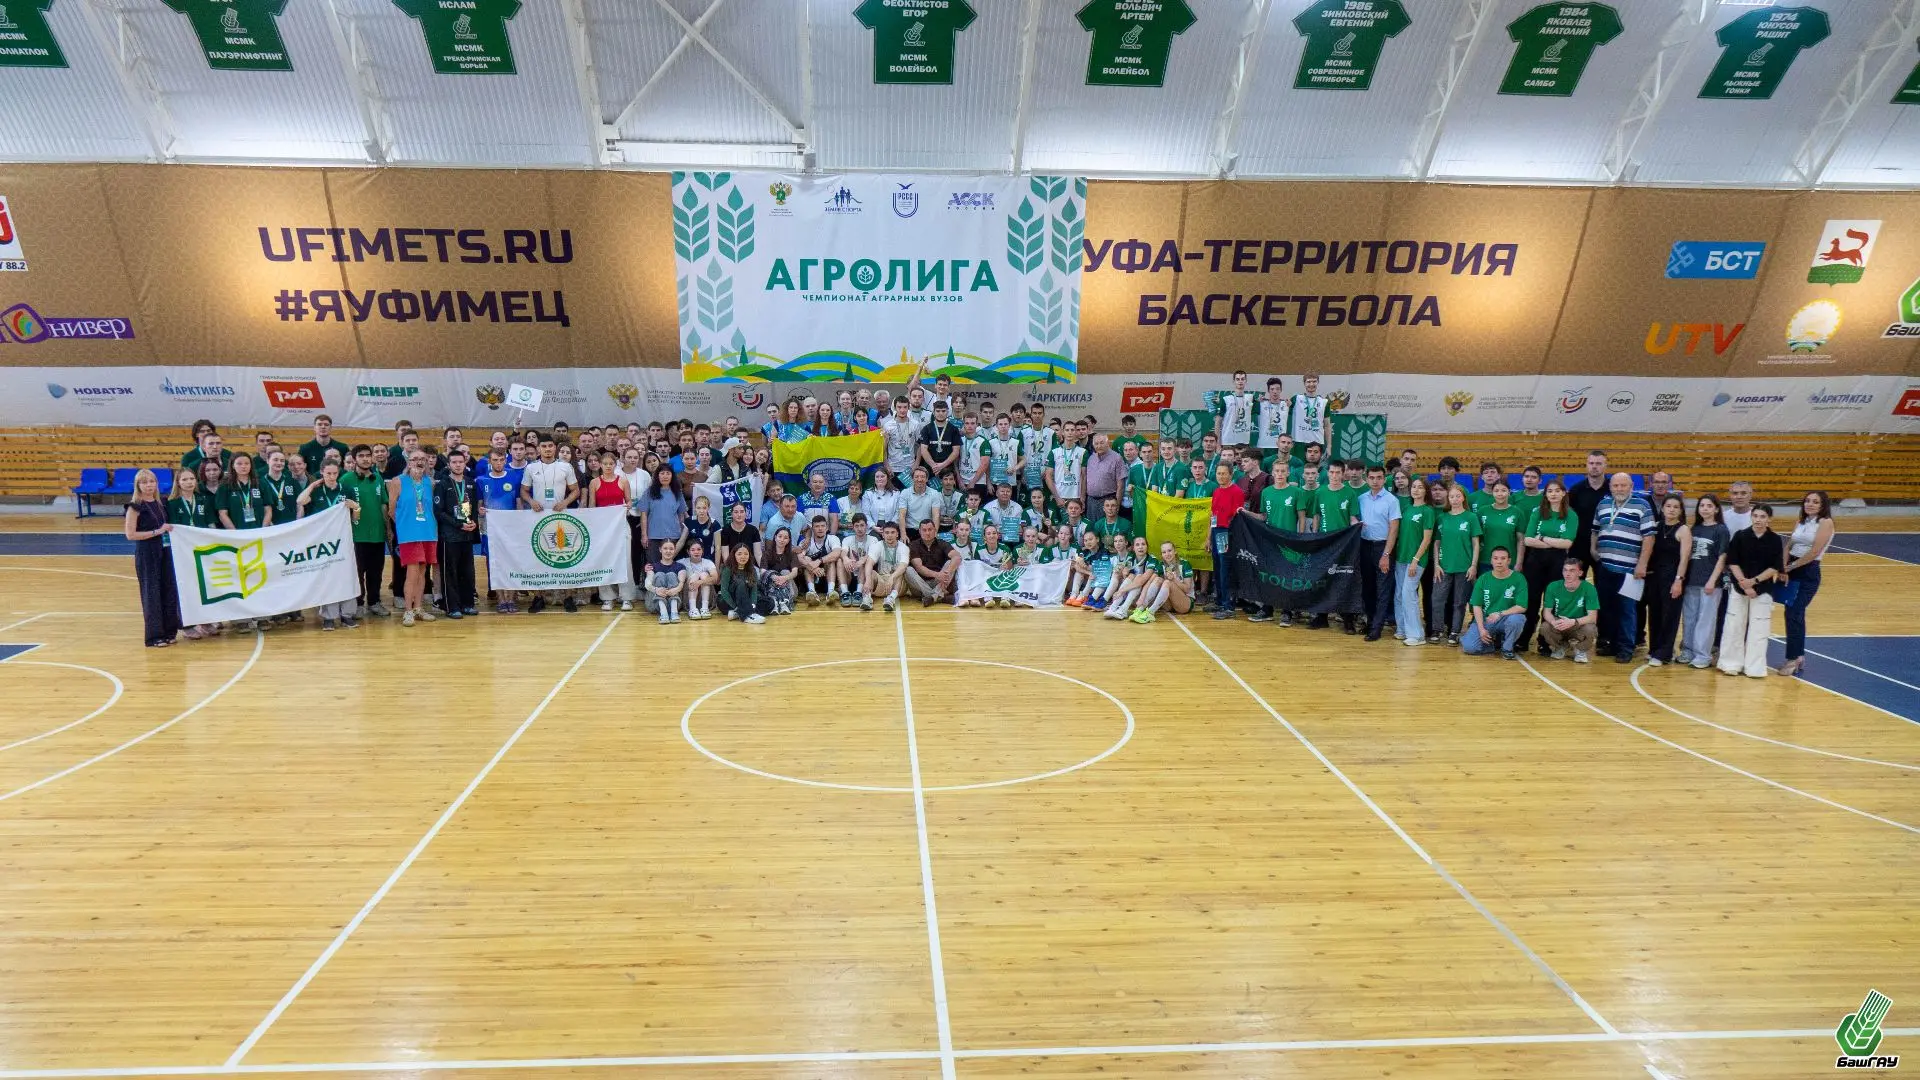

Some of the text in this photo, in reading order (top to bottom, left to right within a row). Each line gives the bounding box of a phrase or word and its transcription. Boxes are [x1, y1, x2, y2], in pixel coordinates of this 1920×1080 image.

[439, 1, 477, 9] ИСЛАМ
[883, 0, 949, 8] ФЕОКТИСТОВ
[1115, 3, 1163, 11] ВОЛЬВИЧ
[1120, 12, 1154, 20] АРТЕМ
[1321, 10, 1389, 19] ЗИНКОВСКИЙ
[1559, 8, 1588, 16] 1984
[1770, 13, 1798, 21] 1974
[1330, 18, 1374, 27] ЕВГЕНИЙ
[1546, 18, 1592, 26] ЯКОВЛЕВ
[1757, 22, 1800, 30] ЮНУСОВ
[1538, 27, 1591, 35] АНАТОЛИЙ
[225, 37, 256, 45] МСМК
[209, 52, 282, 60] ПАУЭРЛИФТИНГ
[1114, 56, 1142, 64] МСМК
[889, 64, 938, 73] ВОЛЕЙБОЛ
[1102, 67, 1150, 75] ВОЛЕЙБОЛ
[258, 227, 573, 263] UFIMETS.RU
[1083, 239, 1518, 276] УФА-ТЕРРИТОРИЯ
[1705, 251, 1761, 270] БСТ
[6, 262, 25, 270] 88.2
[765, 258, 1000, 292] АГРОЛИГА
[802, 294, 867, 302] ЧЕМПИОНАТ
[871, 294, 926, 302] АГРАРНЫХ
[274, 289, 570, 327] #ЯУФИМЕЦ
[1137, 294, 1442, 327] БАСКЕТБОЛА
[1885, 325, 1920, 336] Баш
[1645, 323, 1745, 355] UTV
[73, 387, 133, 395] НОВАТЭК
[175, 386, 235, 395] АРКТИКГАЗ
[357, 386, 419, 397] СИБУР
[1037, 393, 1093, 402] АРКТИКГАЗ
[1821, 395, 1873, 403] АРКТИКГАЗ
[1274, 412, 1281, 423] 3
[1031, 441, 1044, 453] 12
[279, 539, 341, 565] УдГАУ
[509, 571, 549, 579] Казанский
